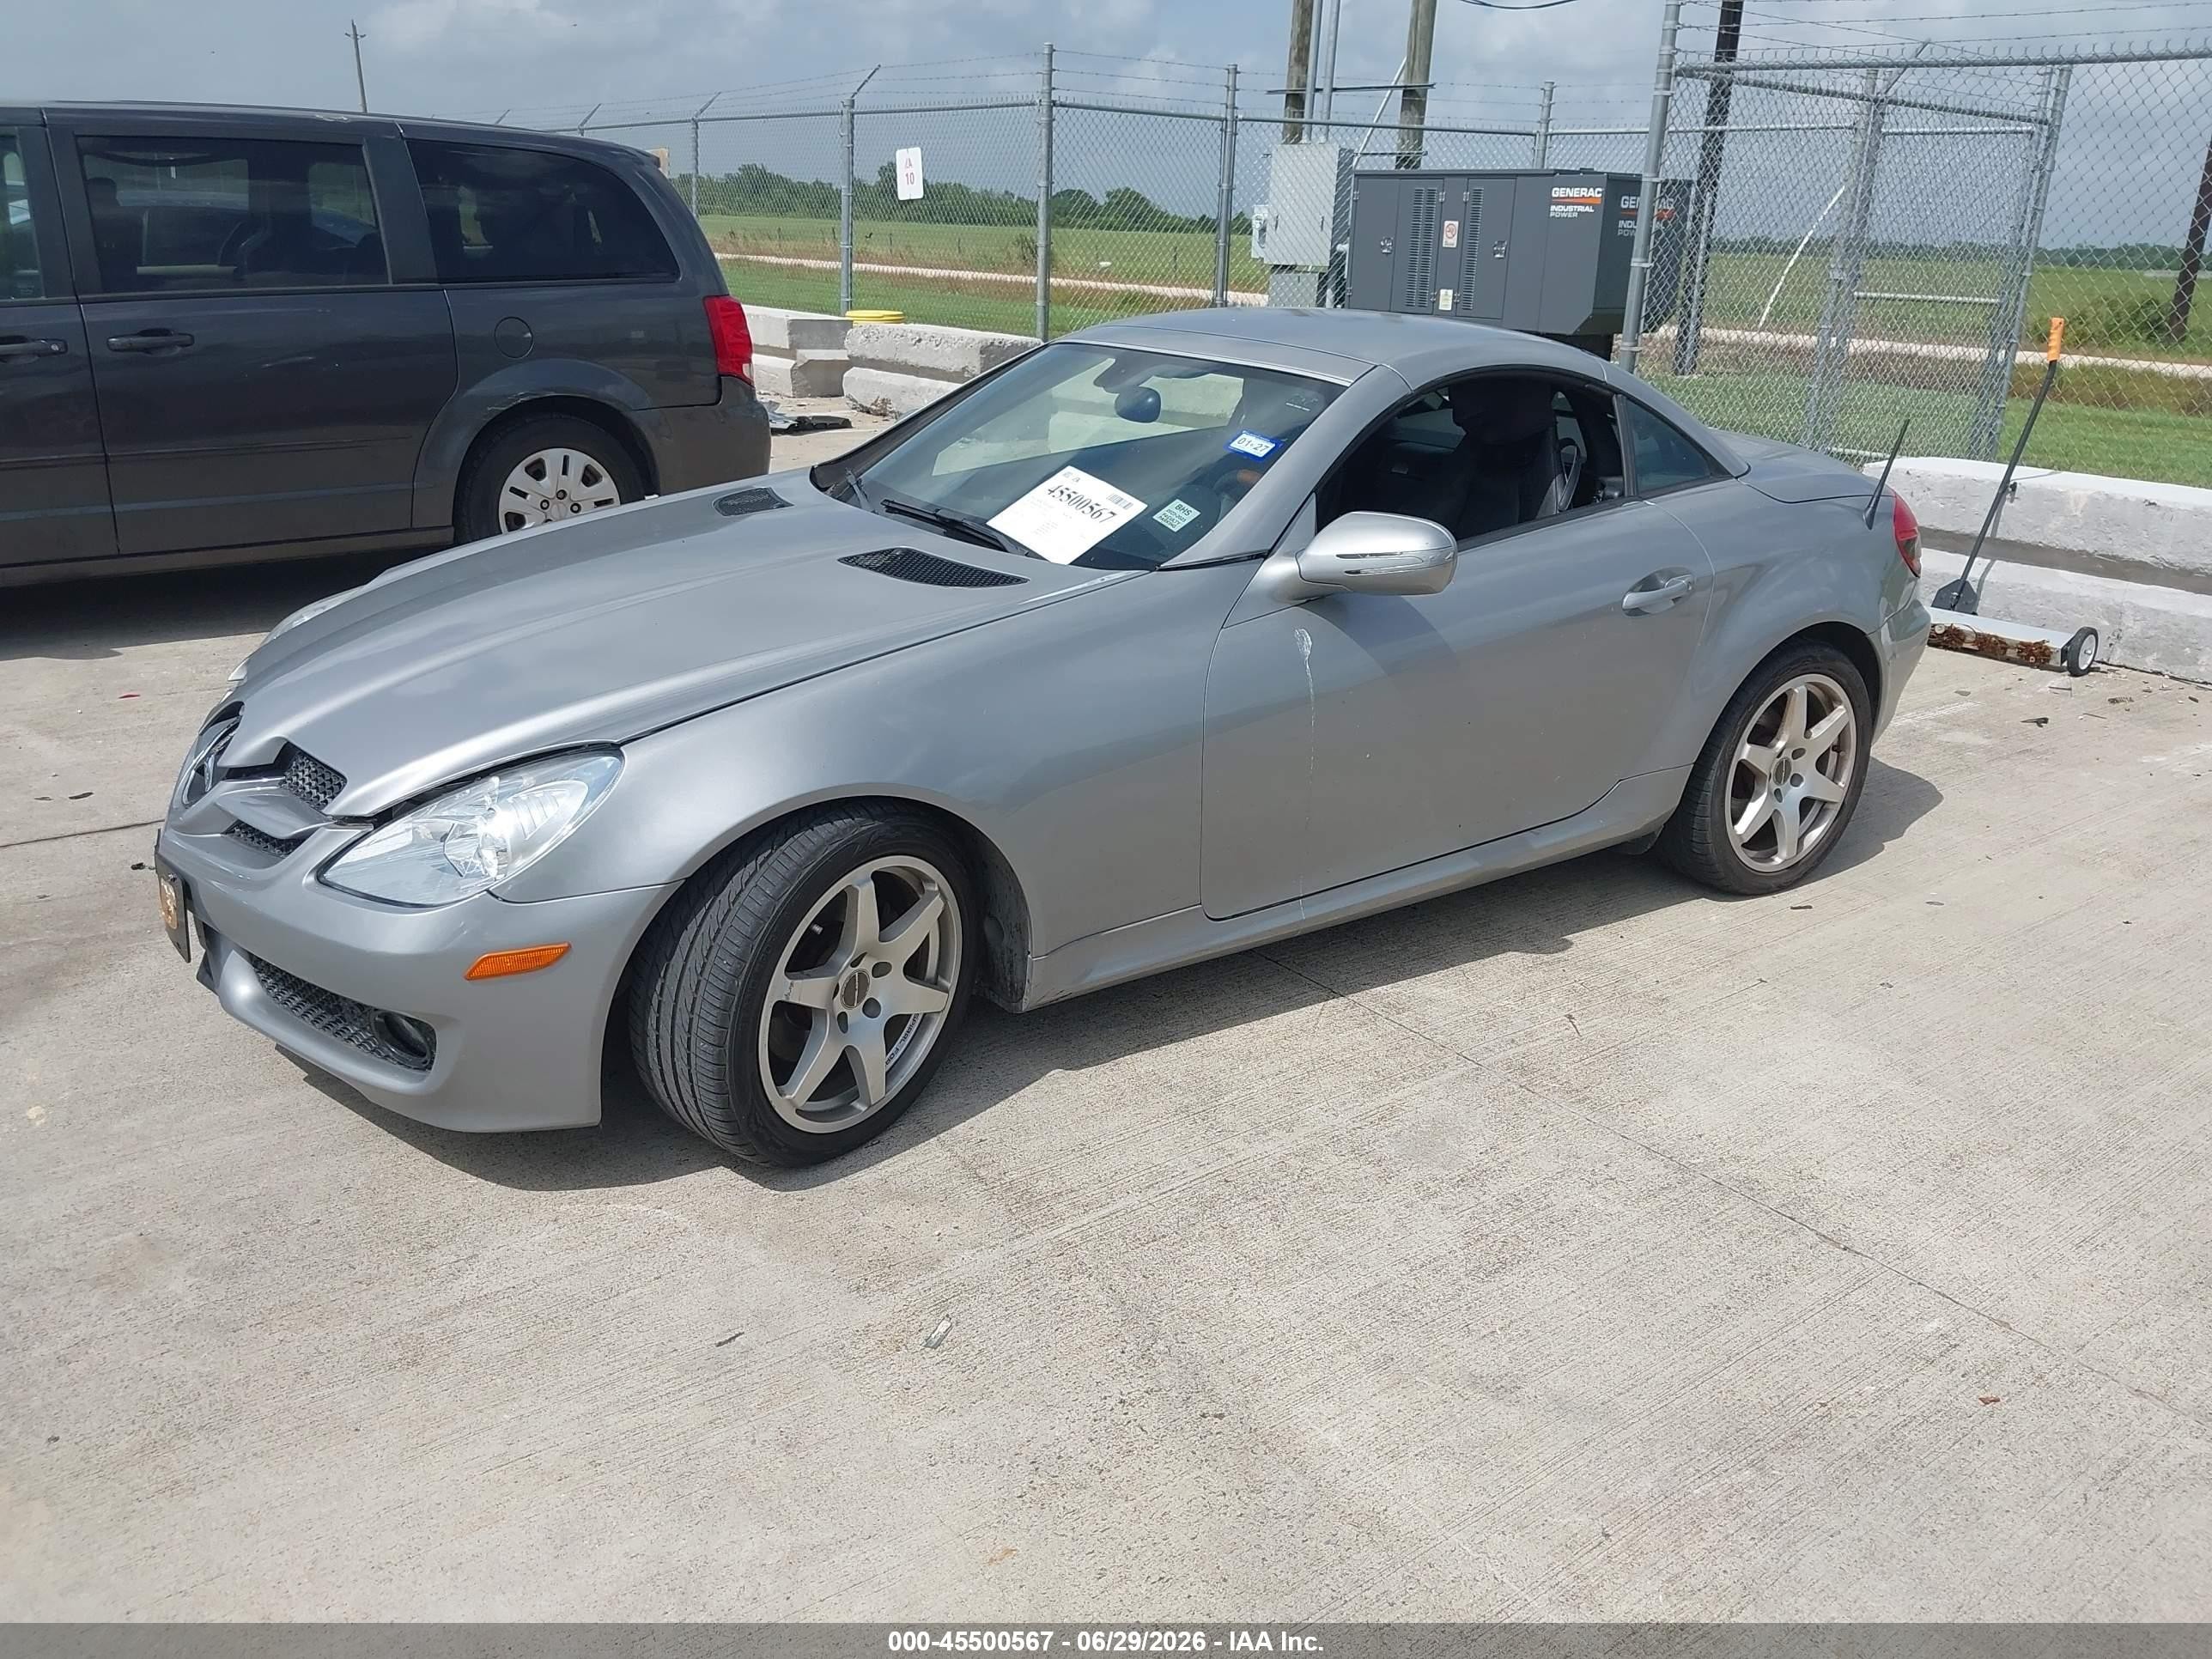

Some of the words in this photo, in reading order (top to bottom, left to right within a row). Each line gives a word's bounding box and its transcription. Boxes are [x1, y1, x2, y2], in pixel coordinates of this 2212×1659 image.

[905, 172, 915, 185] 10
[1552, 187, 1602, 198] GENERAC
[1048, 485, 1117, 523] 45500567
[1175, 503, 1193, 516] BHS
